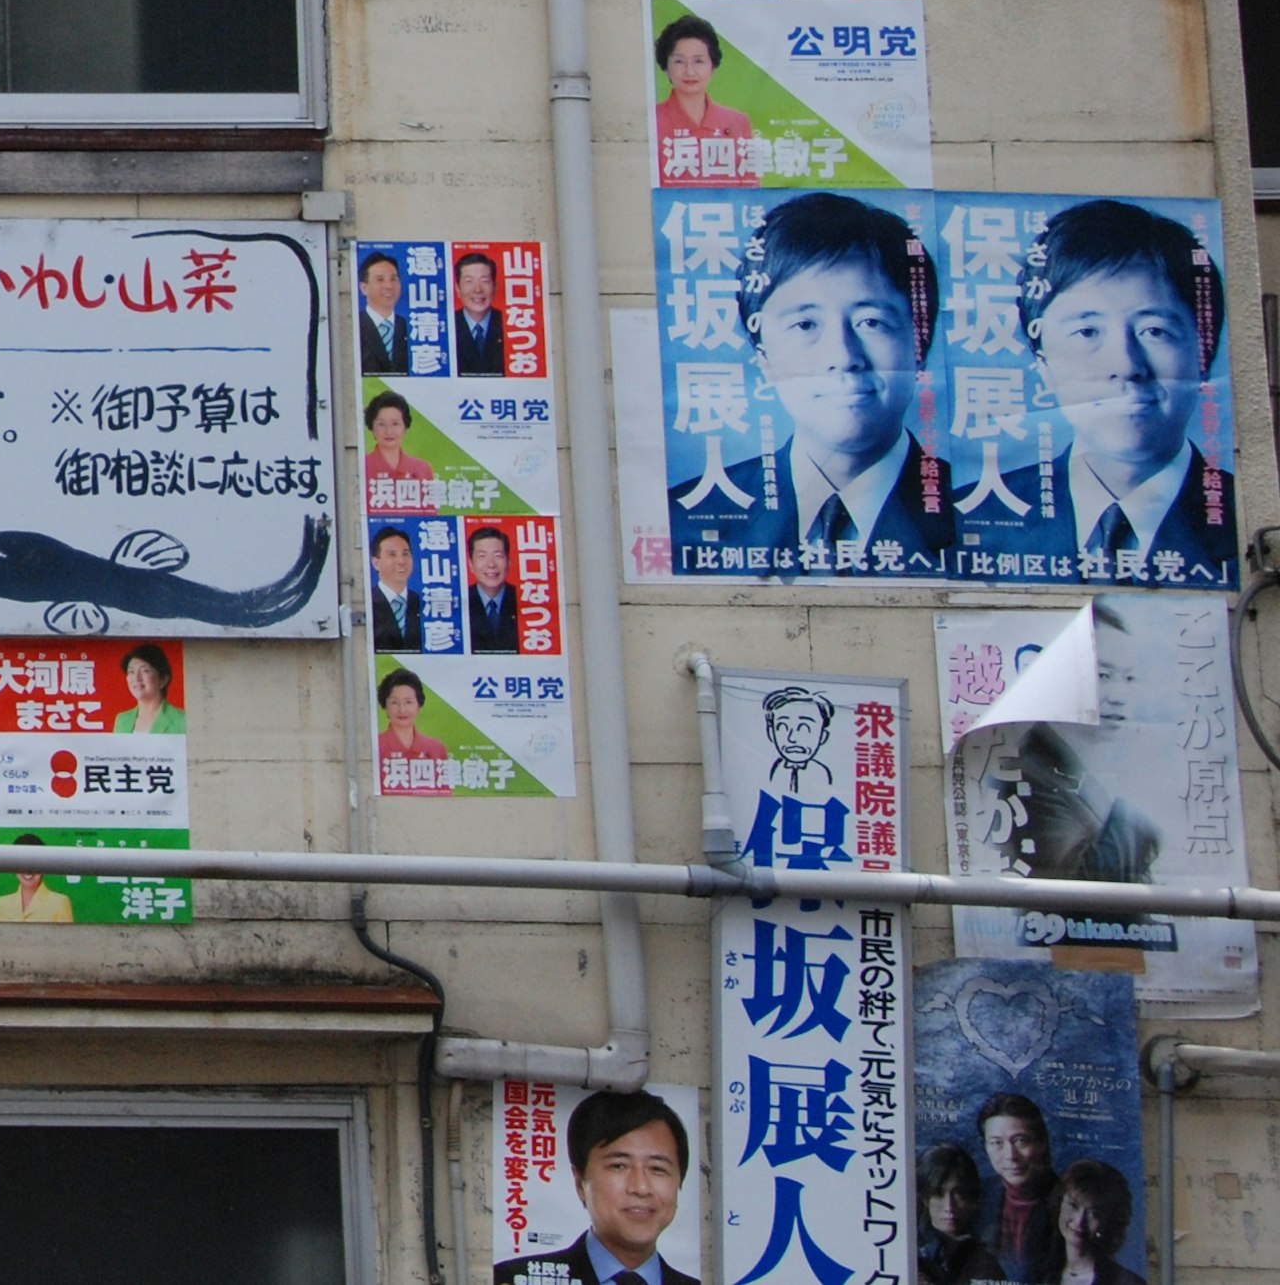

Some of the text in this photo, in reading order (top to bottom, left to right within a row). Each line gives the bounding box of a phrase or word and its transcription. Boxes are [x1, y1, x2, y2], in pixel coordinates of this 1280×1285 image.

[788, 25, 917, 56] 公明党
[663, 137, 848, 178] 浜四津敏子
[503, 246, 538, 374] 山口なつお
[661, 202, 755, 511] 保坂展人
[941, 205, 1032, 517] 保坂展人
[458, 399, 549, 421] 公明党
[54, 447, 329, 505] 御相談に応じます。
[682, 539, 946, 576] 「比例区は社民党へ」
[956, 548, 1229, 585] 「比例区は社民党へ」
[516, 521, 552, 651] 山口なつお
[472, 677, 564, 699] 公明党
[16, 700, 104, 730] まさこ
[84, 764, 175, 794] 民主党
[121, 887, 186, 920] 洋子
[725, 951, 745, 1226] さか のぶ と
[532, 1082, 556, 1183] 元気印で
[504, 1081, 528, 1253] 国会を変える!
